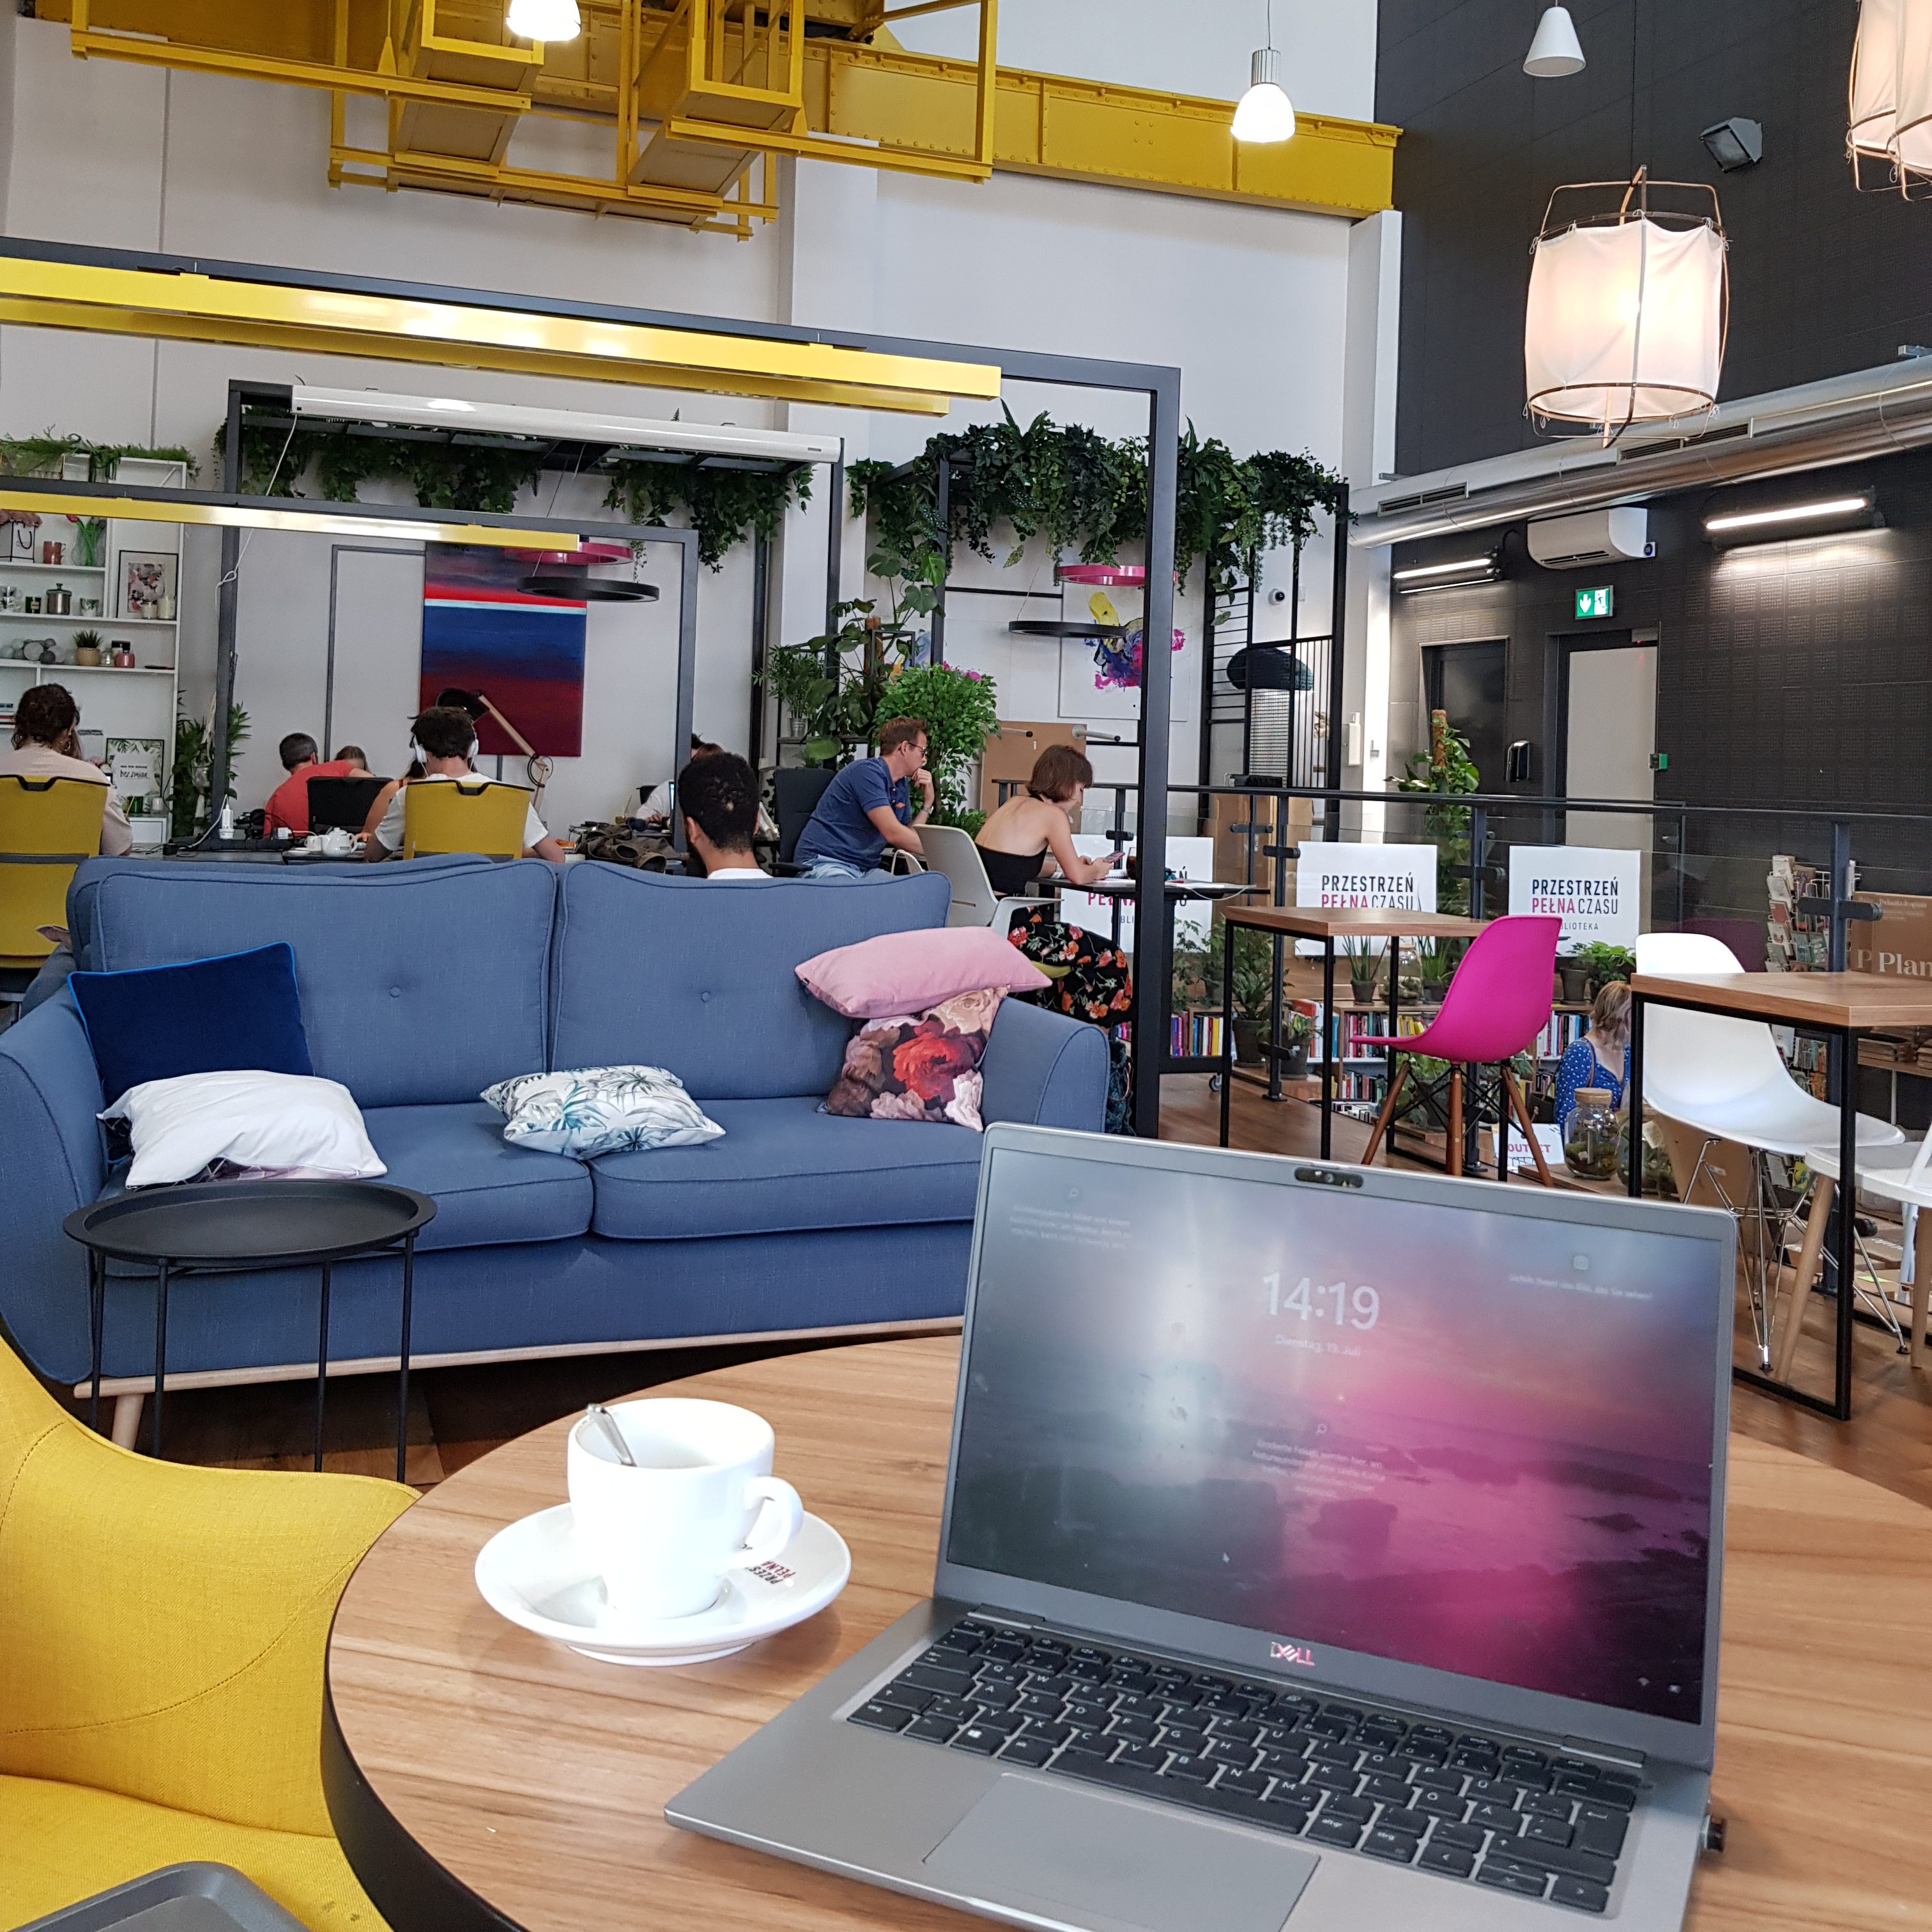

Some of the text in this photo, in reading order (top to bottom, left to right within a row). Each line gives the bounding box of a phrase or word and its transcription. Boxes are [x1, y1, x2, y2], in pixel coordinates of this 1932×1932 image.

[1322, 871, 1413, 893] PRZESTRZEŃ
[1532, 877, 1618, 896] PRZESTRZEŃ
[1508, 1144, 1551, 1153] OUTT
[1262, 1272, 1379, 1330] 14:19
[1269, 1641, 1315, 1666] DELL
[1230, 1768, 1243, 1777] N
[1282, 1781, 1296, 1790] M
[1321, 1765, 1331, 1774] K
[1374, 1778, 1381, 1786] L
